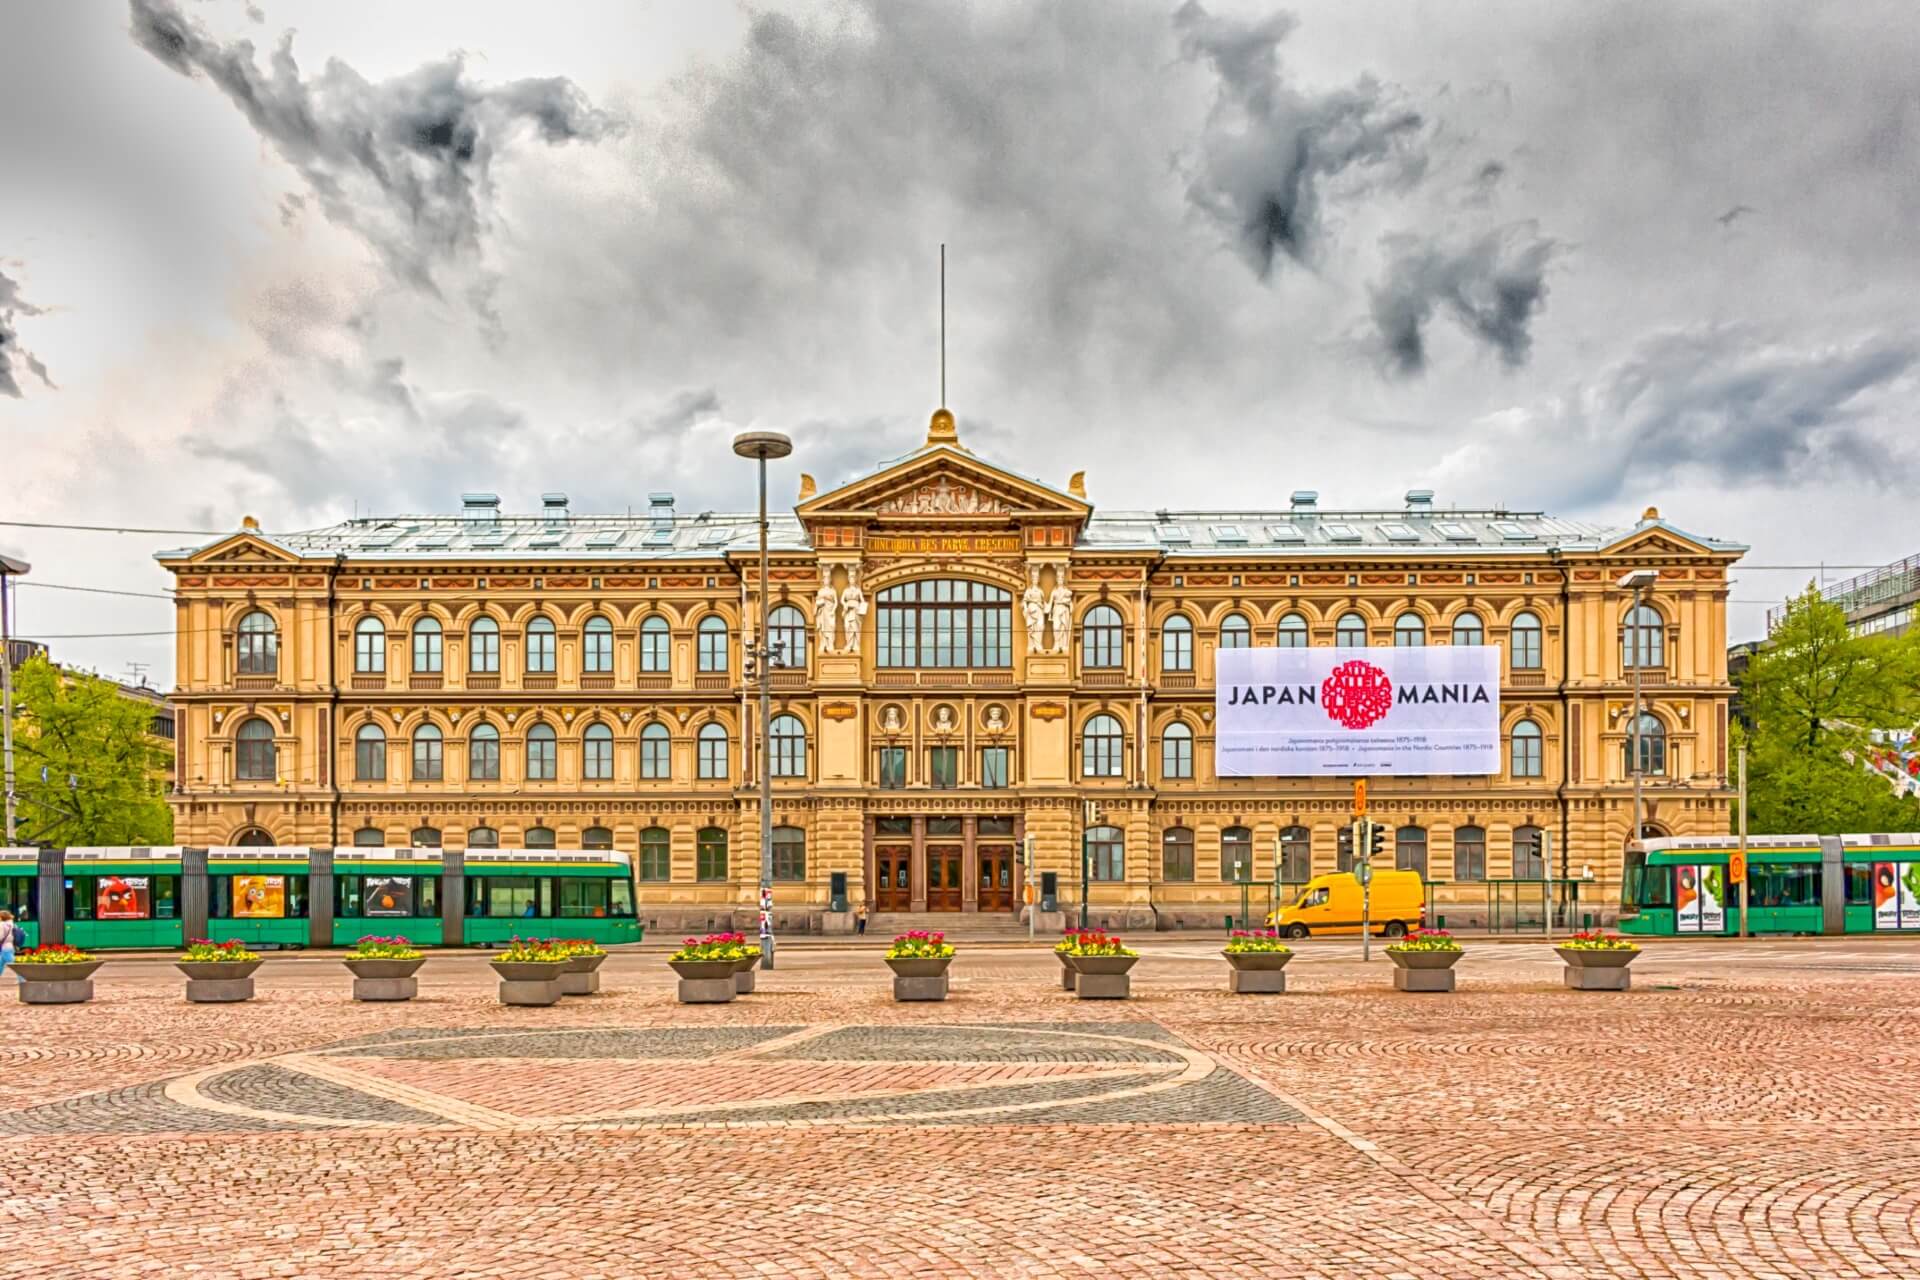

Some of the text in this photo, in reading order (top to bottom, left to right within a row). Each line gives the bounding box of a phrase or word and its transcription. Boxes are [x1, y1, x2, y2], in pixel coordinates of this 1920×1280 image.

[920, 538, 938, 551] RES
[975, 538, 1020, 551] CRESCUNT
[1228, 685, 1316, 705] JAPAN
[1397, 683, 1490, 704] MANIA
